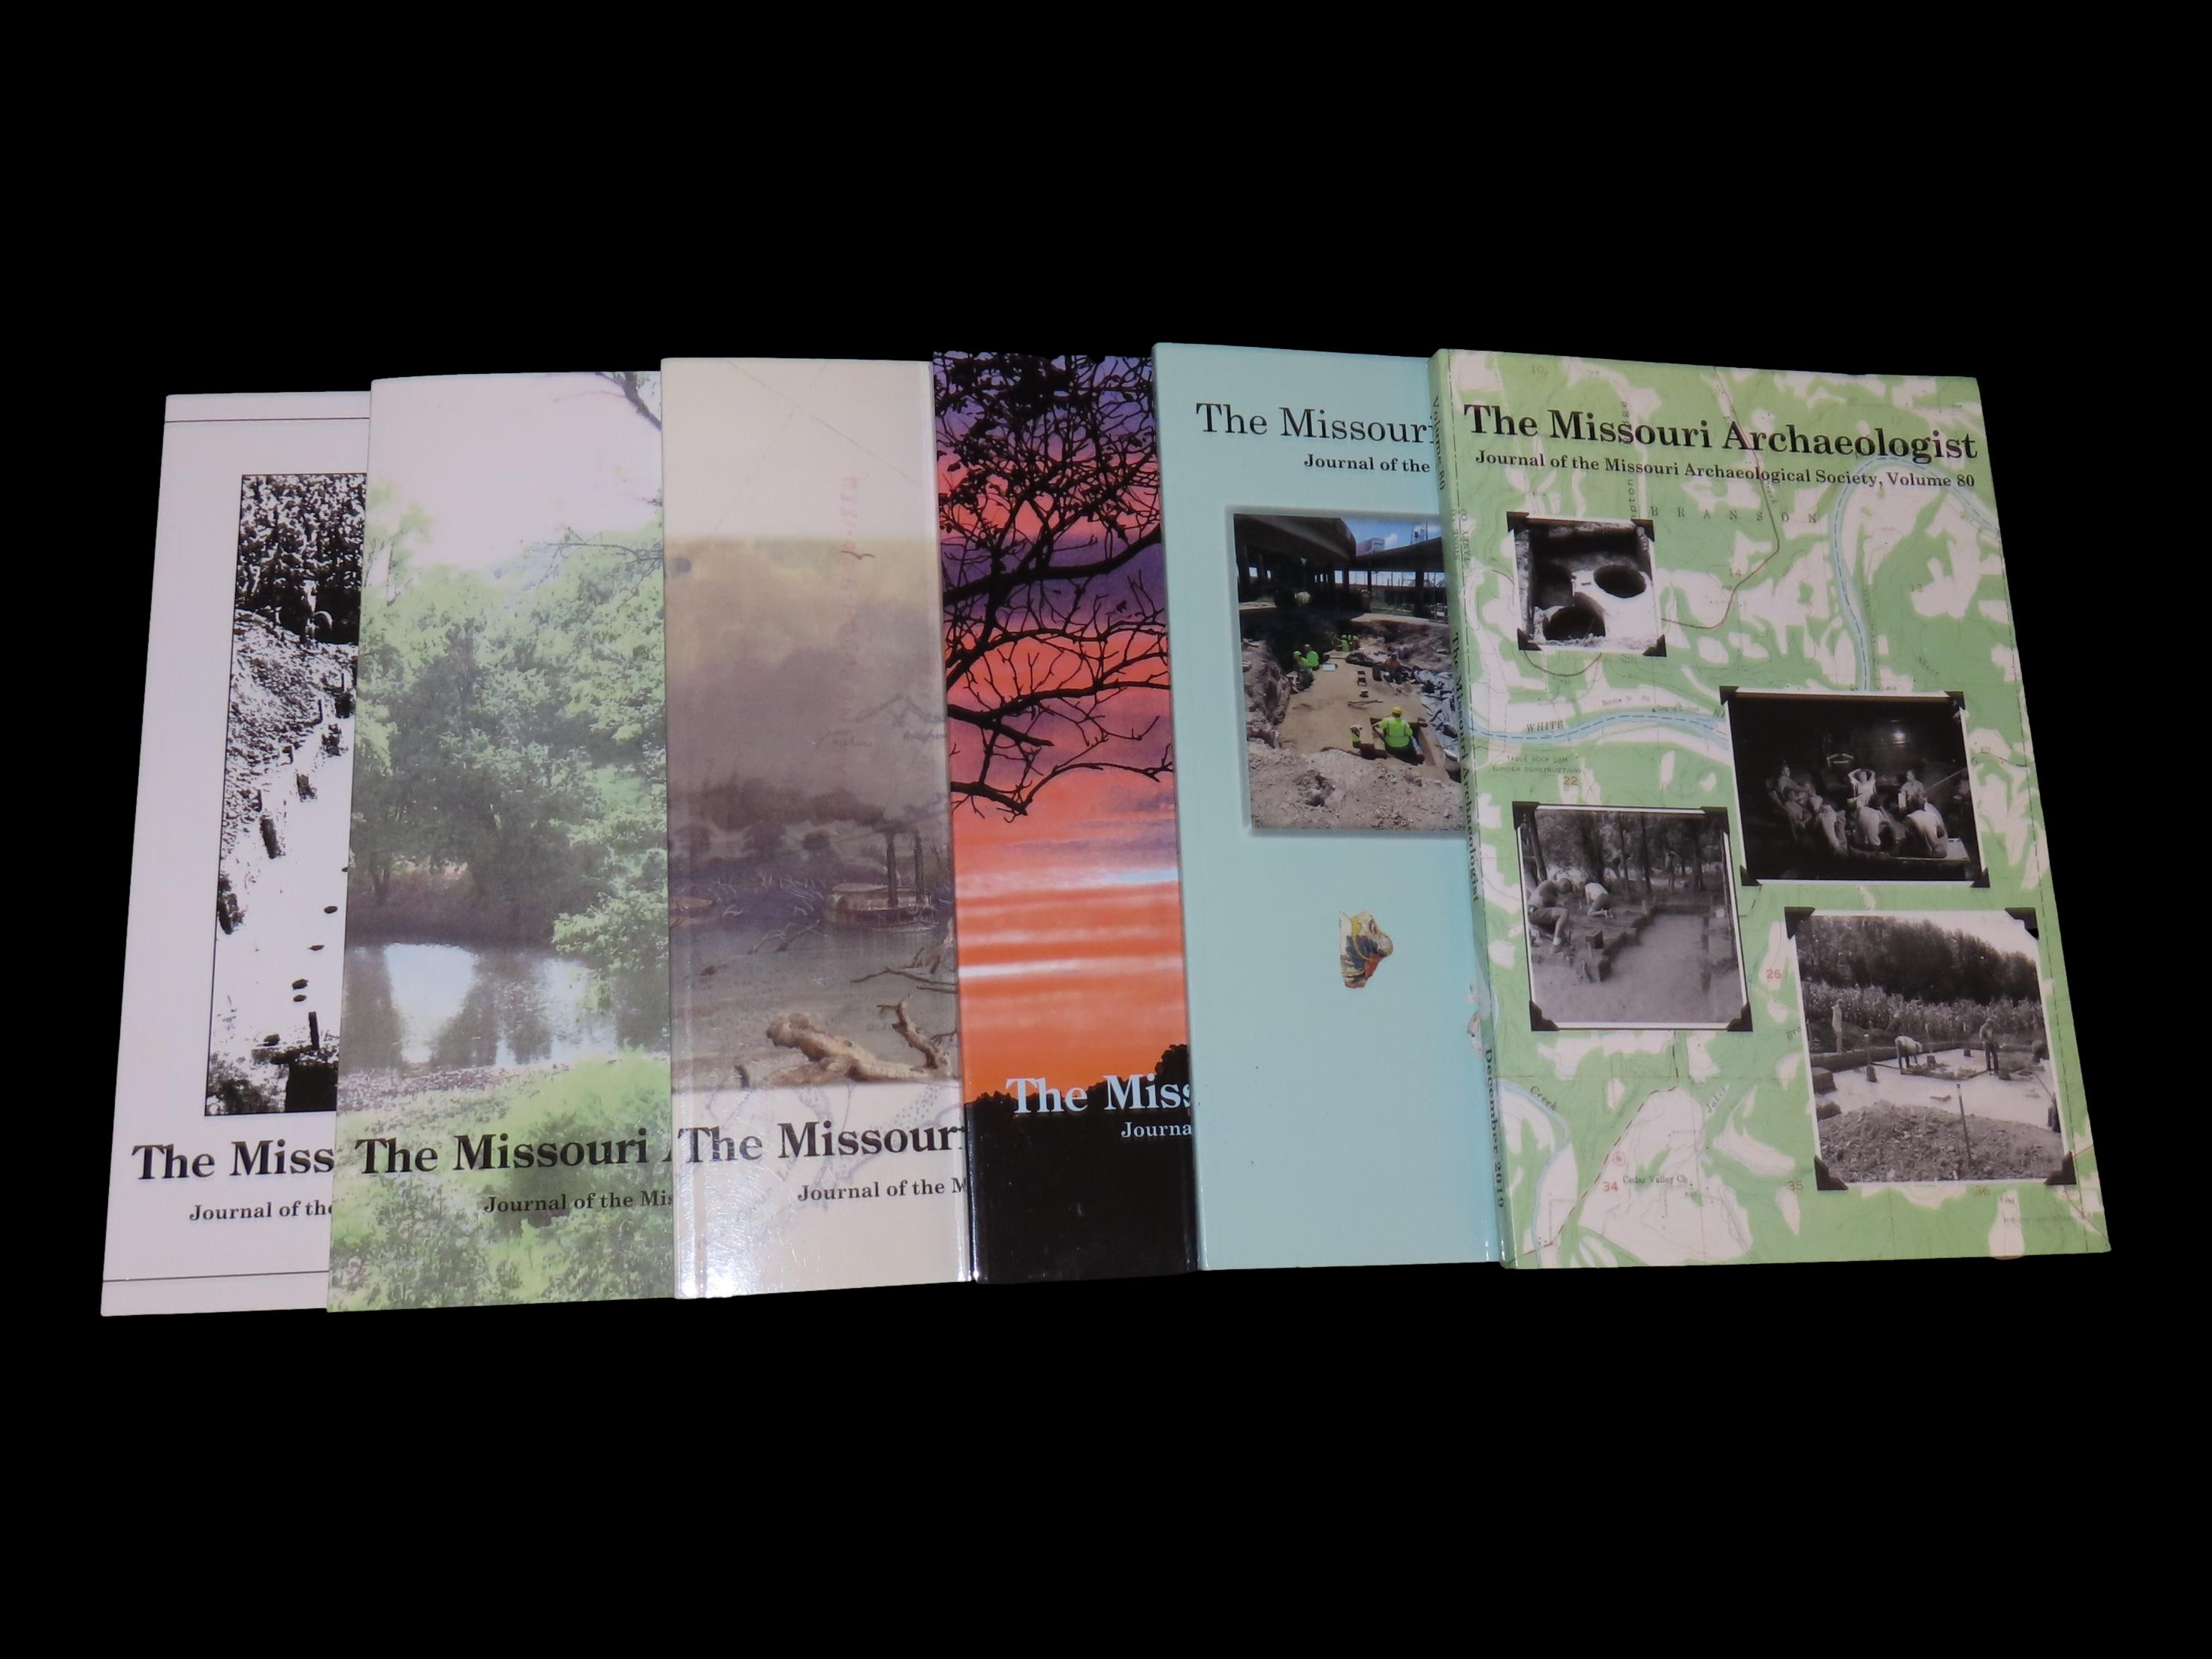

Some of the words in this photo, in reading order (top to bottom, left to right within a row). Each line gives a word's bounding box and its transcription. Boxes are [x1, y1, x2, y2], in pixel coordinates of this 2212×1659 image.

[1196, 402, 1268, 436] The
[1464, 403, 1538, 437] The
[1547, 409, 1713, 449] Missouri
[1722, 420, 1978, 464] Archaeologist
[1432, 397, 1443, 465] Volume
[1438, 470, 1446, 490] 80
[1304, 453, 1375, 471] Journal
[1380, 457, 1398, 472] of
[1402, 458, 1431, 473] the
[1475, 449, 1546, 467] Journal
[1550, 454, 1569, 469] of
[1572, 456, 1599, 471] the
[1604, 457, 1679, 476] Missouri
[1685, 461, 1811, 484] Archaeological
[1815, 469, 1884, 487] Society,
[1886, 471, 1951, 487] Volume
[1957, 474, 1975, 487] 80
[1452, 632, 1460, 671] The
[1455, 675, 1469, 760] Missouri
[1526, 719, 1564, 734] WHITE
[1563, 775, 1579, 786] 22
[1462, 768, 1480, 902] Archaeologist
[1766, 969, 1782, 979] 26
[1005, 1076, 1088, 1114] The
[677, 1126, 764, 1163] The
[1121, 1121, 1193, 1139] Journa
[1484, 1049, 1499, 1154] December
[1494, 1160, 1505, 1208] 2019
[131, 1142, 216, 1181] The
[228, 1138, 335, 1177] Miss
[355, 1136, 439, 1175] The
[452, 1127, 650, 1172] Missouri
[797, 1181, 880, 1202] Journal
[886, 1180, 907, 1197] of
[912, 1178, 946, 1196] the
[1602, 1181, 1619, 1193] 34
[1622, 1175, 1646, 1184] Cedar
[1649, 1174, 1675, 1185] Valley
[1676, 1174, 1688, 1184] Ch
[1787, 1180, 1804, 1191] 35
[189, 1201, 273, 1221] Journal
[279, 1200, 302, 1217] of
[484, 1193, 566, 1214] Journal
[573, 1192, 596, 1210] of
[600, 1190, 633, 1208] the
